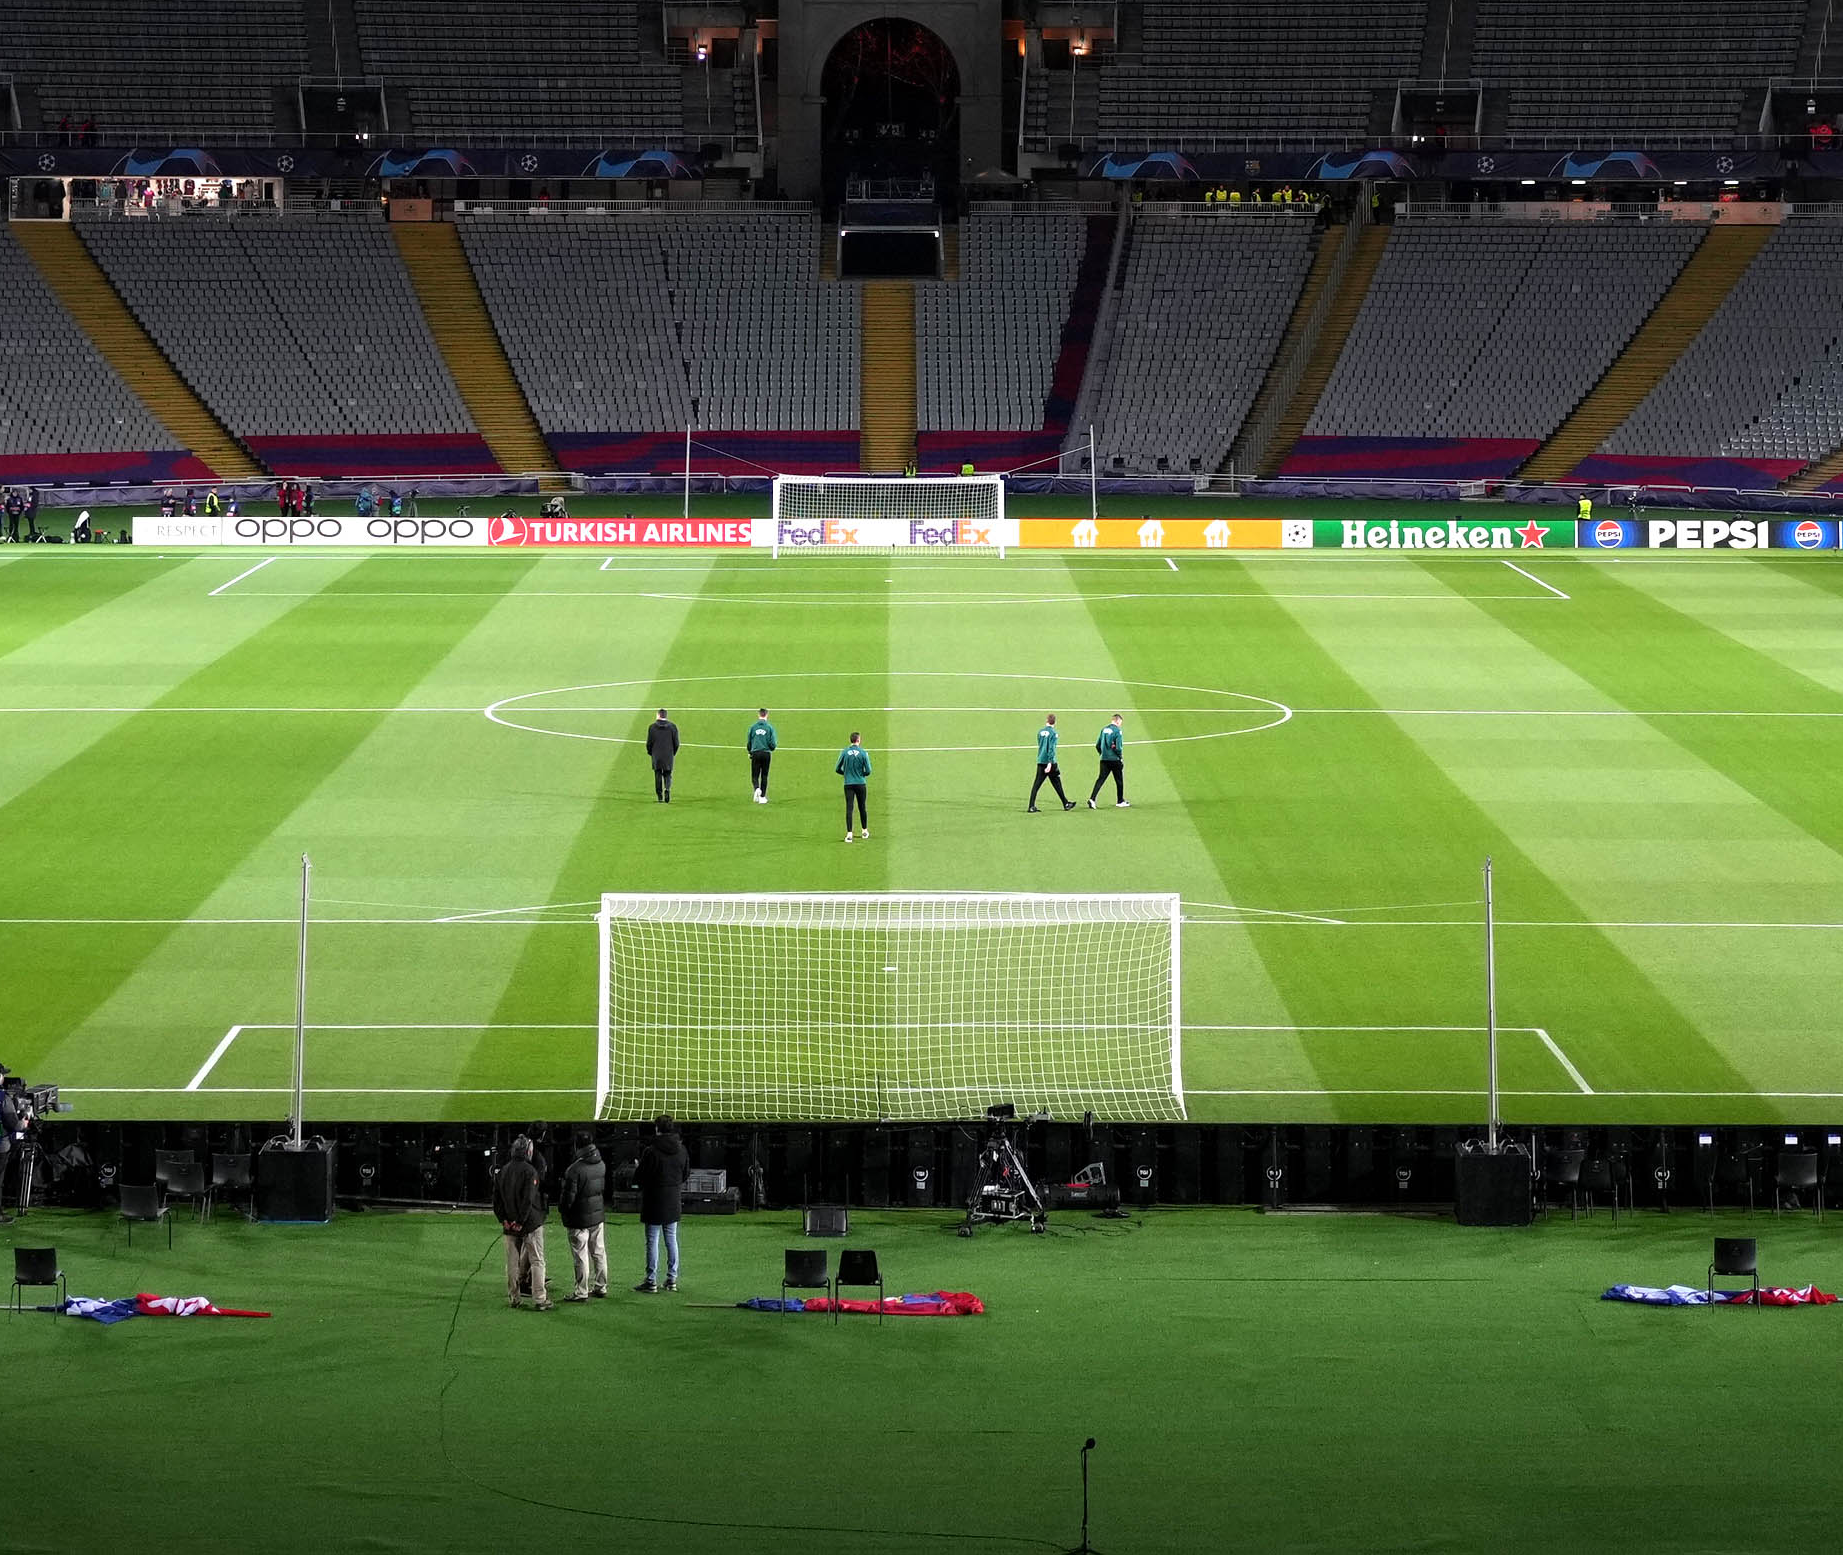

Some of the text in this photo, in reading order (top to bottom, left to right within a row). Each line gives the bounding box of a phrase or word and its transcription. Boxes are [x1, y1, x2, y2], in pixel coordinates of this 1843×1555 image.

[157, 525, 218, 537] RESPECT
[235, 519, 342, 544] oppo
[366, 519, 473, 544] oppo
[529, 523, 752, 542] TURKISH AIRLINES
[778, 520, 859, 545] FedEx
[910, 520, 991, 545] FedEx
[1341, 520, 1513, 548] Heineken
[1648, 520, 1768, 549] PEPSI
